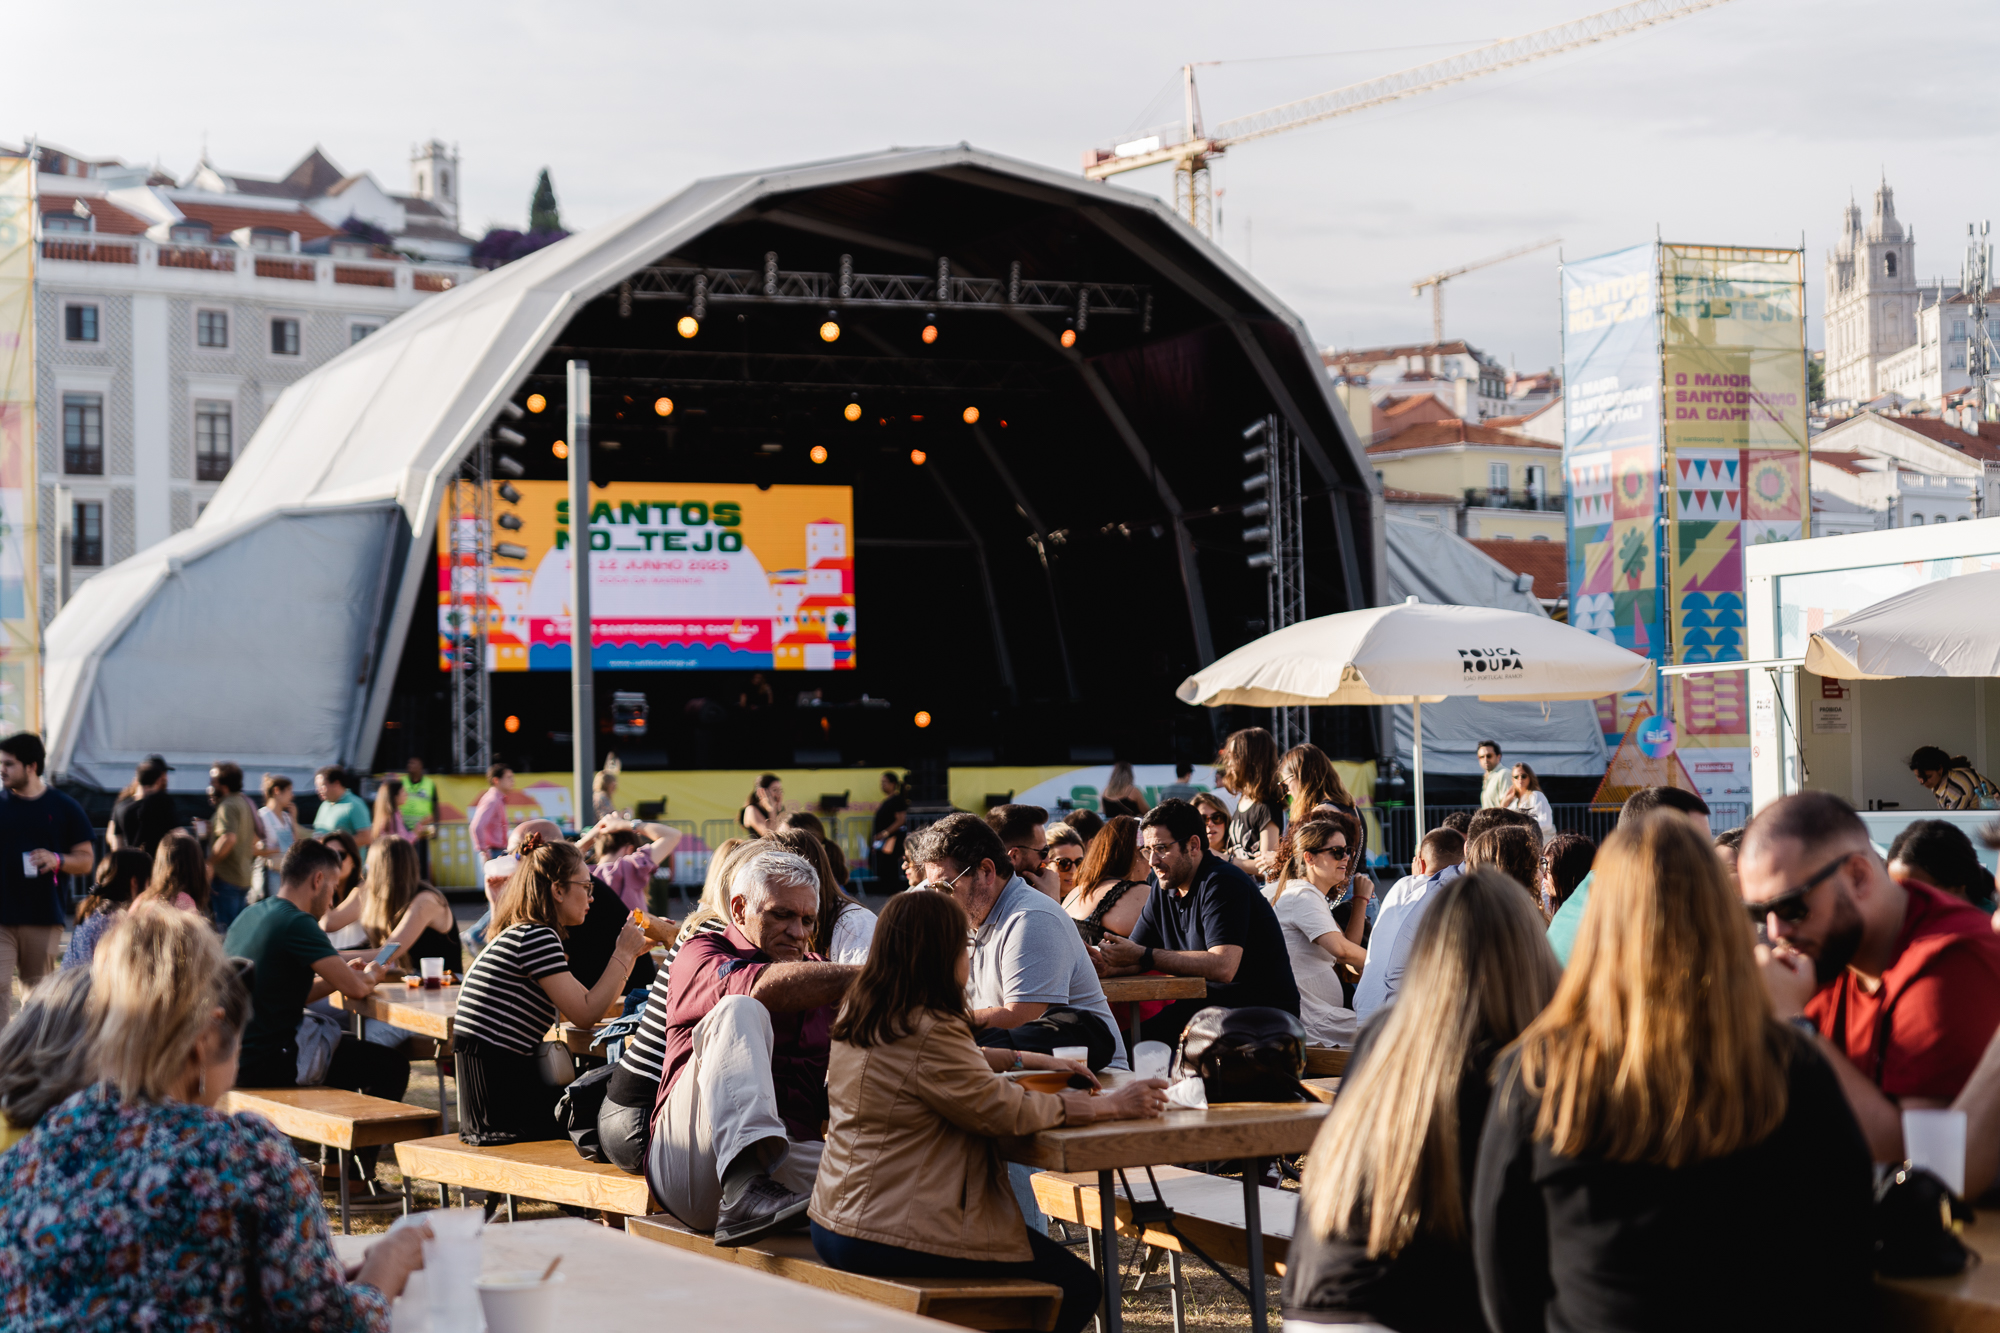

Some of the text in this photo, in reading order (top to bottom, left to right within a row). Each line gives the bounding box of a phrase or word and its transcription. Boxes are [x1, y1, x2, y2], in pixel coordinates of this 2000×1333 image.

[1569, 271, 1649, 311] SANTOS
[1675, 372, 1751, 387] O MAIOR
[1570, 384, 1580, 399] O
[1676, 407, 1699, 420] DA
[1457, 647, 1521, 658] POUCA
[1463, 658, 1523, 673] ROUPA
